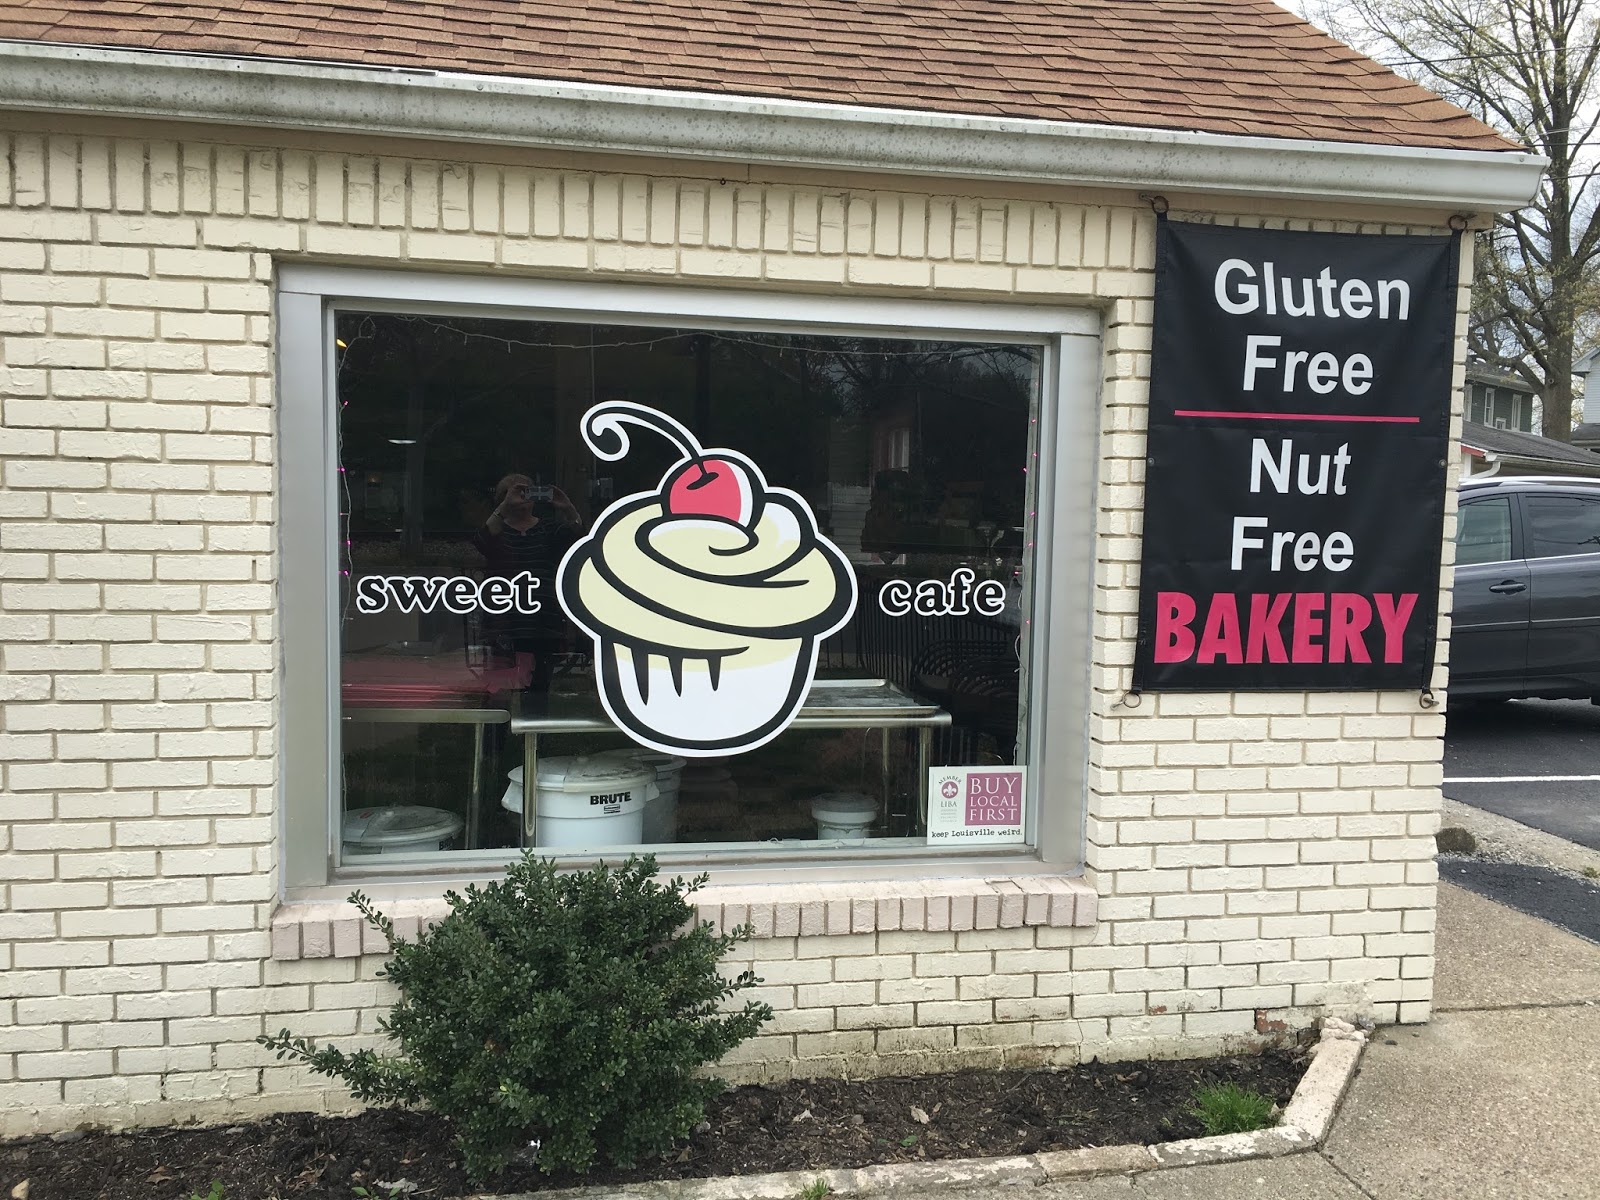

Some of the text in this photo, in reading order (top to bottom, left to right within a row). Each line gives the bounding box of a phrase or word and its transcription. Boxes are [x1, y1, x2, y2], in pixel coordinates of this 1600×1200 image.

[1214, 258, 1411, 320] Gluten
[1243, 335, 1374, 395] Free
[1249, 438, 1352, 495] Nut
[1231, 516, 1354, 572] Free
[356, 568, 1006, 616] sweet cafe
[1153, 591, 1419, 664] BAKERY
[938, 775, 962, 785] MEMBER
[970, 777, 1018, 795] BUY
[590, 791, 632, 805] BRUTE
[969, 808, 1018, 821] FIRST
[970, 795, 1018, 807] LOCAL
[951, 828, 995, 837] Louisville
[997, 828, 1023, 836] weird.
